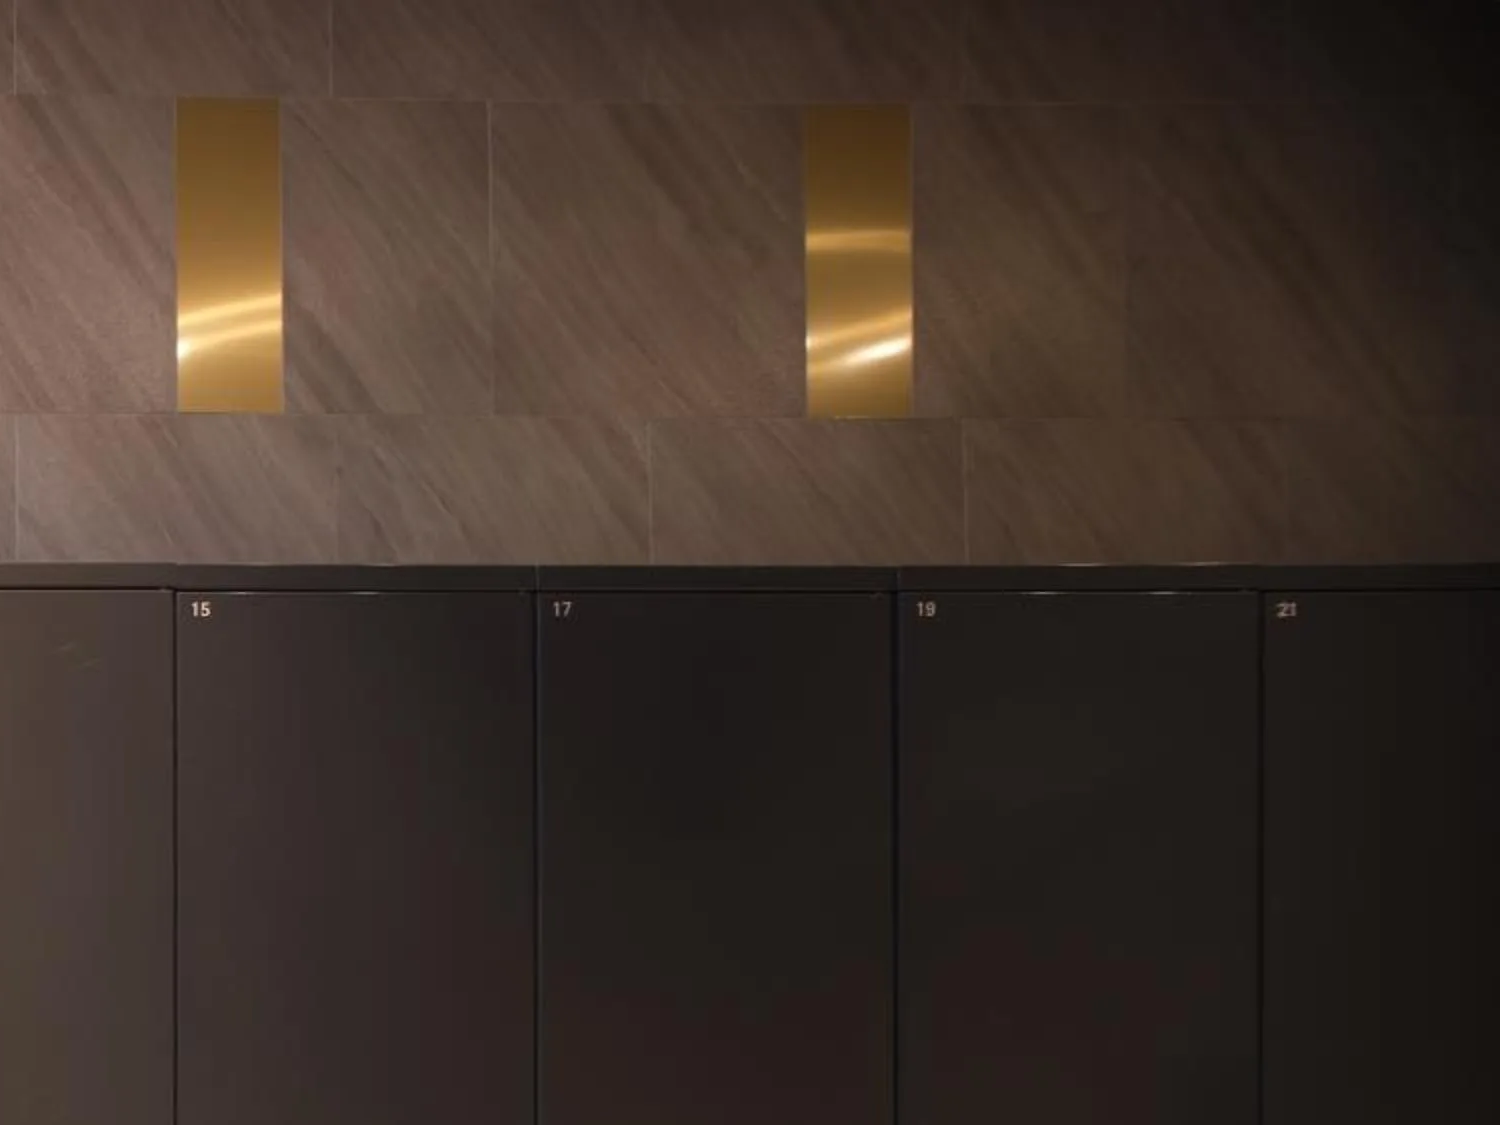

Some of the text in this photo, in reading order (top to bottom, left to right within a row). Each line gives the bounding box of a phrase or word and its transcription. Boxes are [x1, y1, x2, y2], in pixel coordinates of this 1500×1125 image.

[191, 601, 211, 617] 15
[553, 601, 572, 617] 17
[917, 601, 936, 617] 19
[1276, 602, 1297, 618] 21
